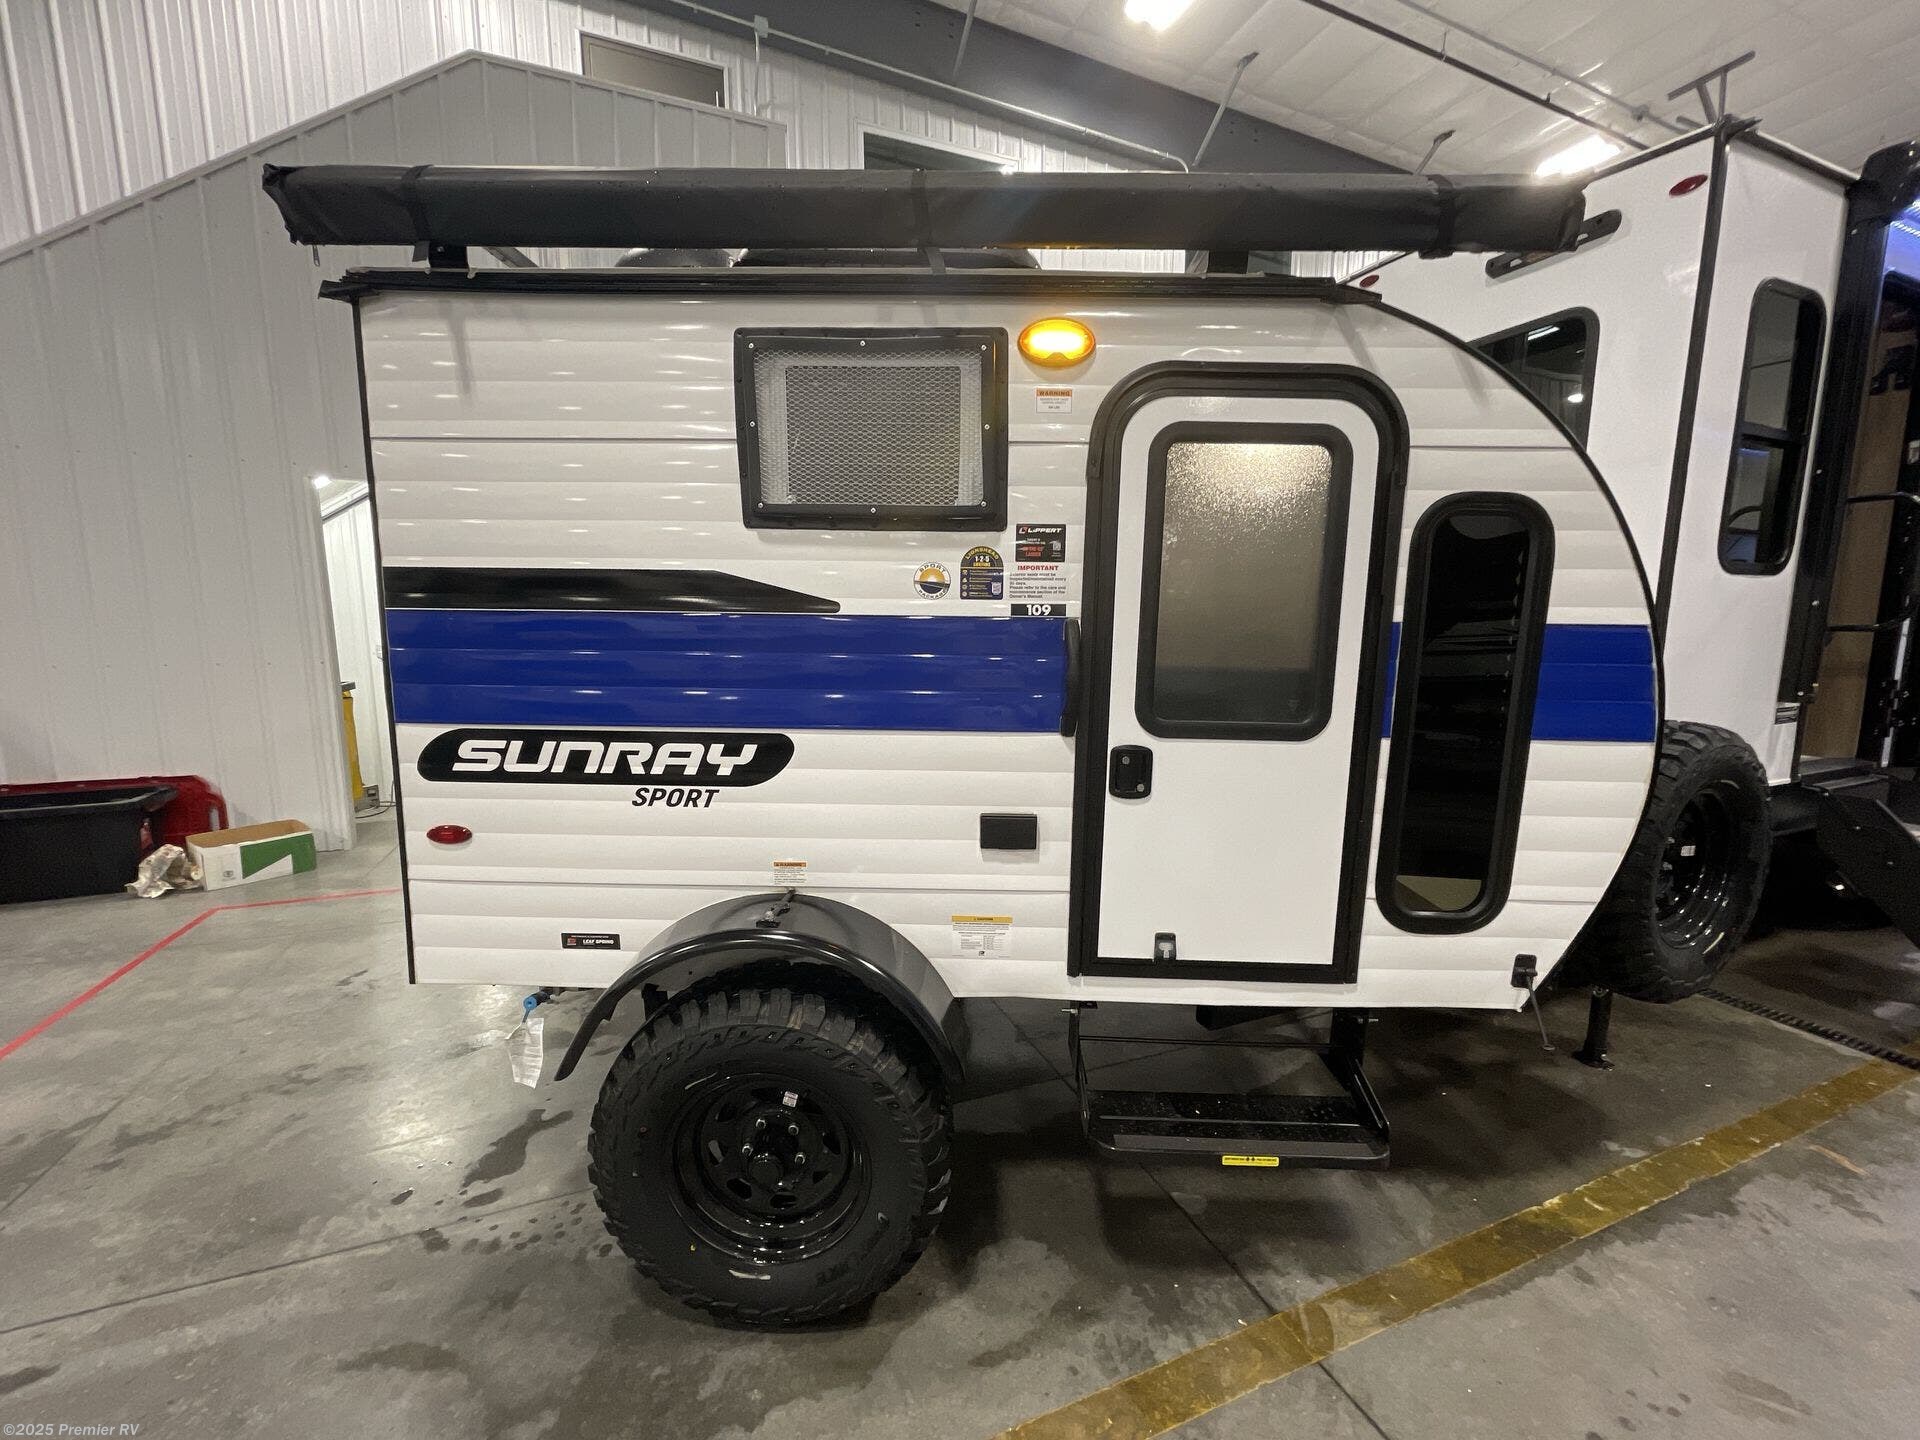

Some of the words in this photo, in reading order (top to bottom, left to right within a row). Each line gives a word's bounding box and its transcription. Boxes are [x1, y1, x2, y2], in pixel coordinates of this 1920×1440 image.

[919, 562, 946, 573] SPORT
[1026, 604, 1052, 616] 109
[452, 739, 758, 776] SUNRAY
[631, 787, 720, 809] SPORT
